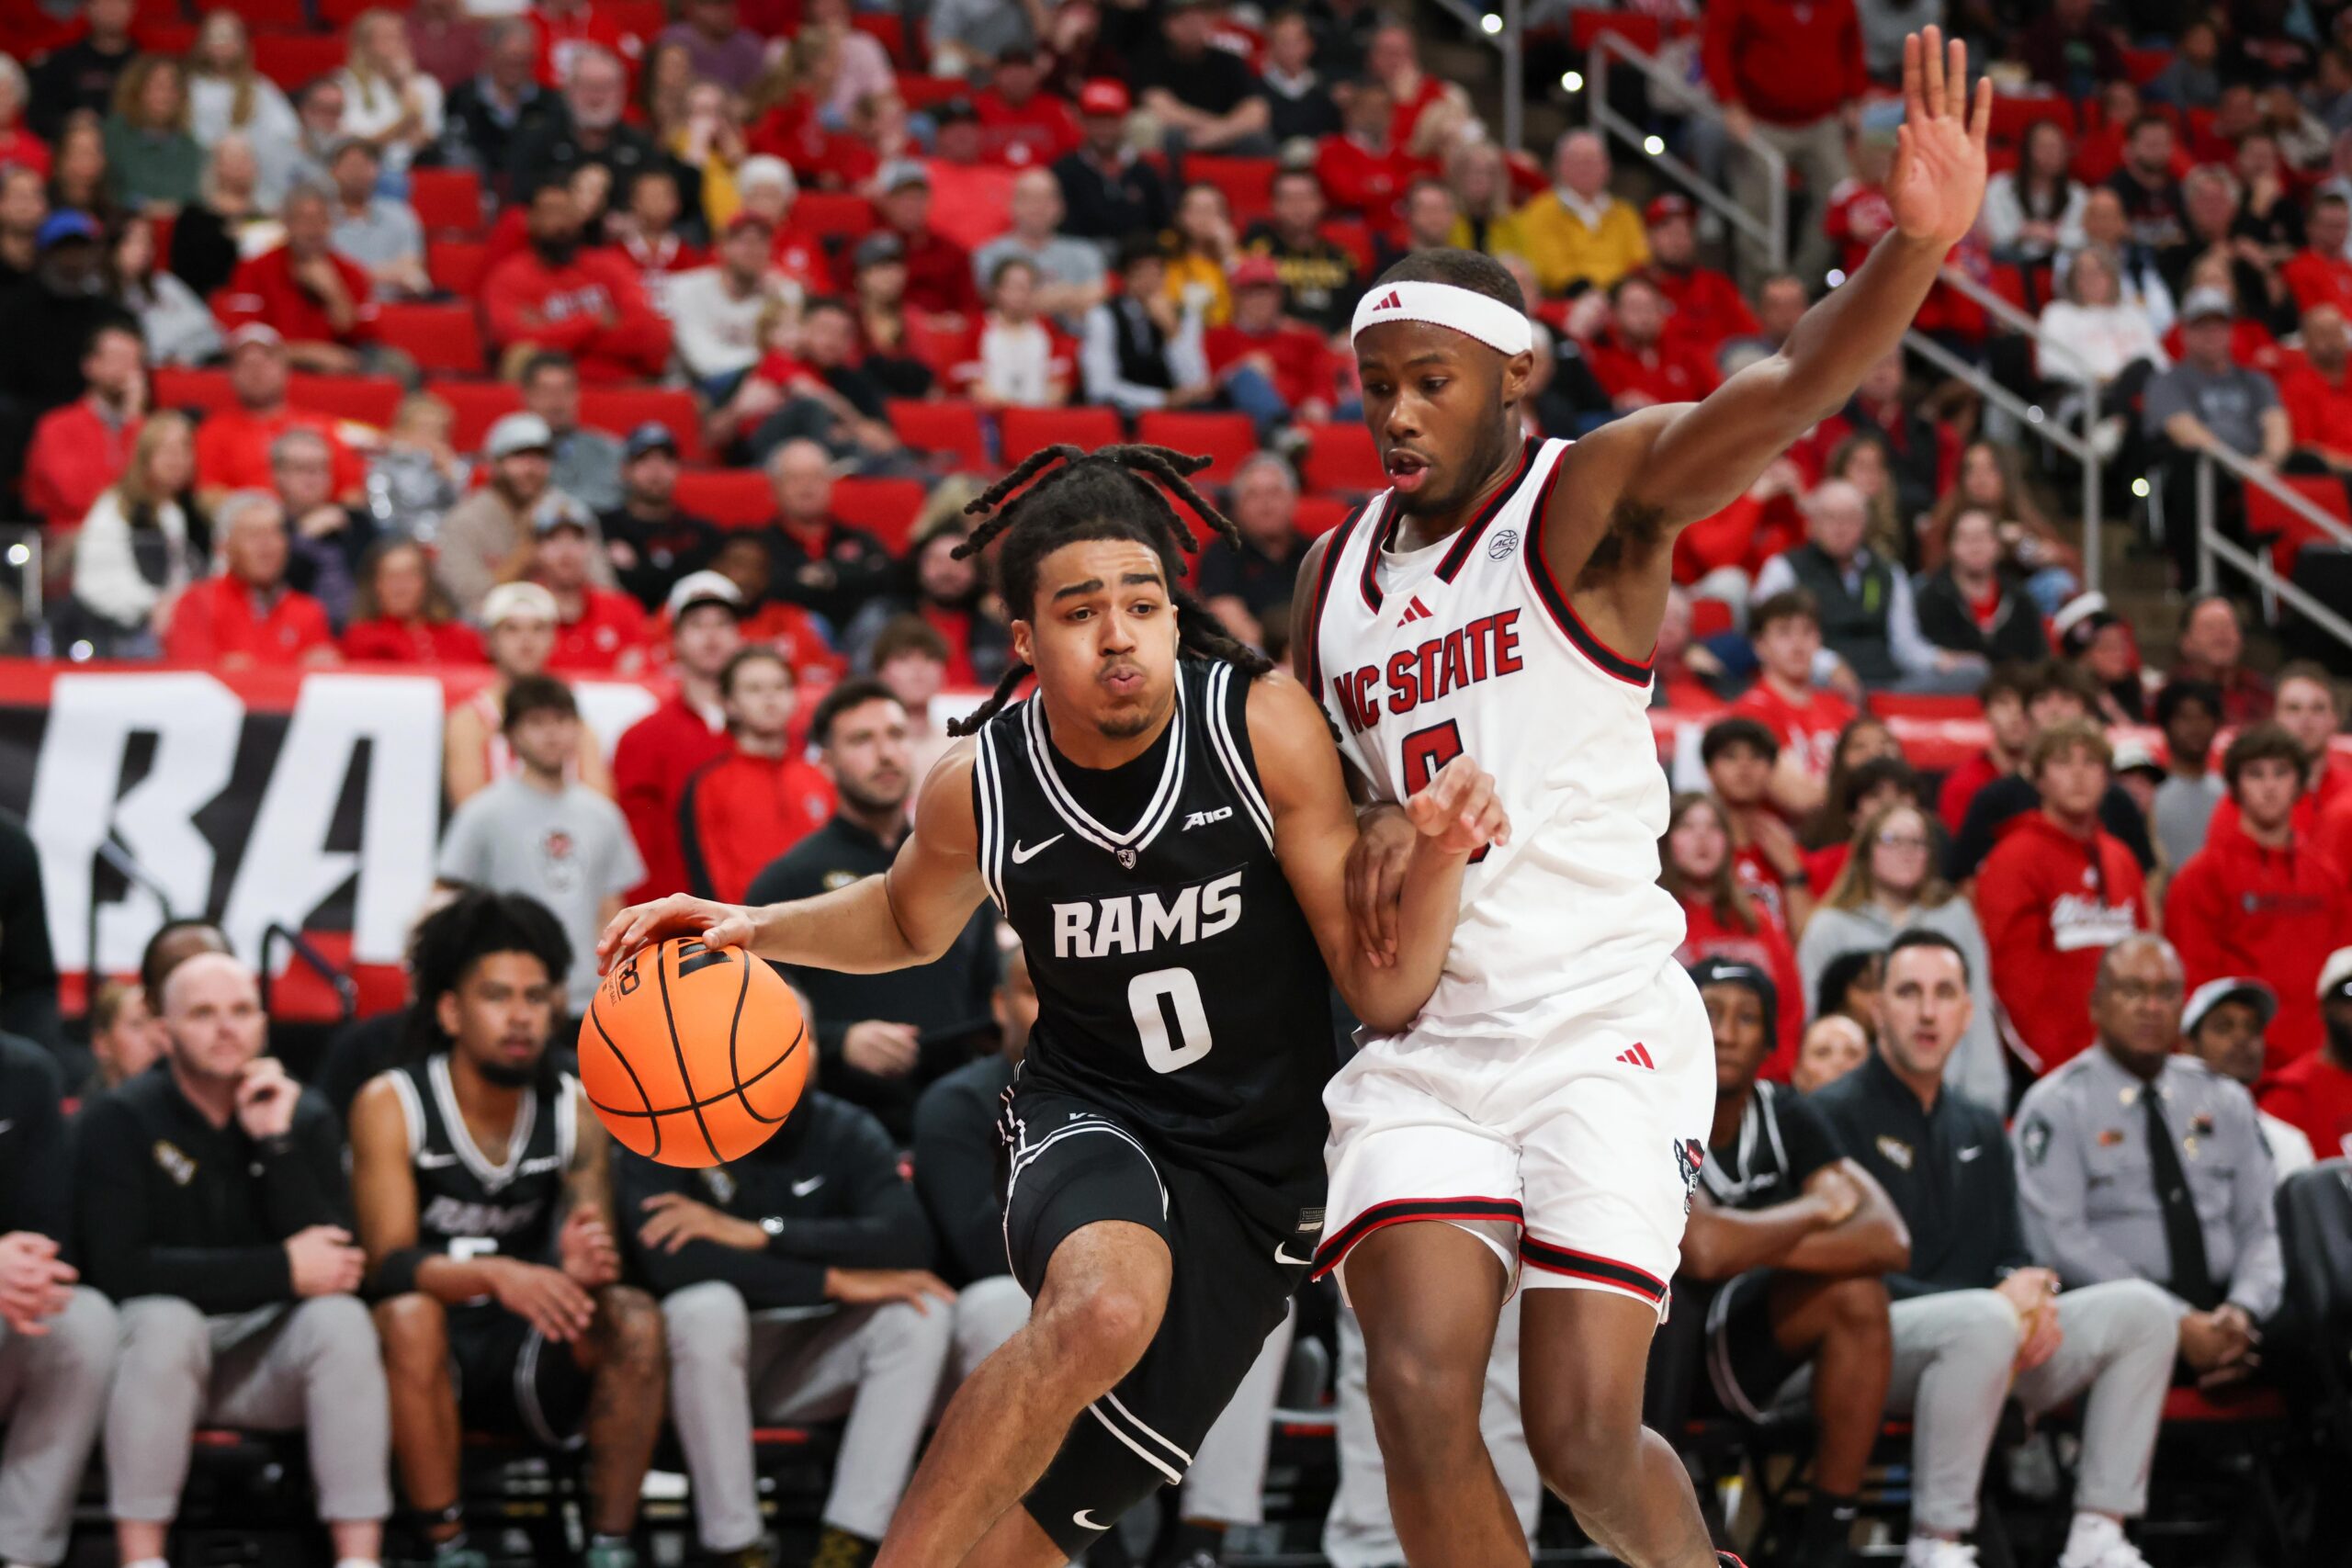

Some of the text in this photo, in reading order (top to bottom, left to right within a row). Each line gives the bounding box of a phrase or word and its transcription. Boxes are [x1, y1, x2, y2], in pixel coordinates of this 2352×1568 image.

[1491, 537, 1517, 548] ACC
[1333, 606, 1523, 736] NC STATE
[1182, 806, 1233, 832] A10
[1051, 870, 1242, 958] RAMS
[1127, 966, 1213, 1074] 0
